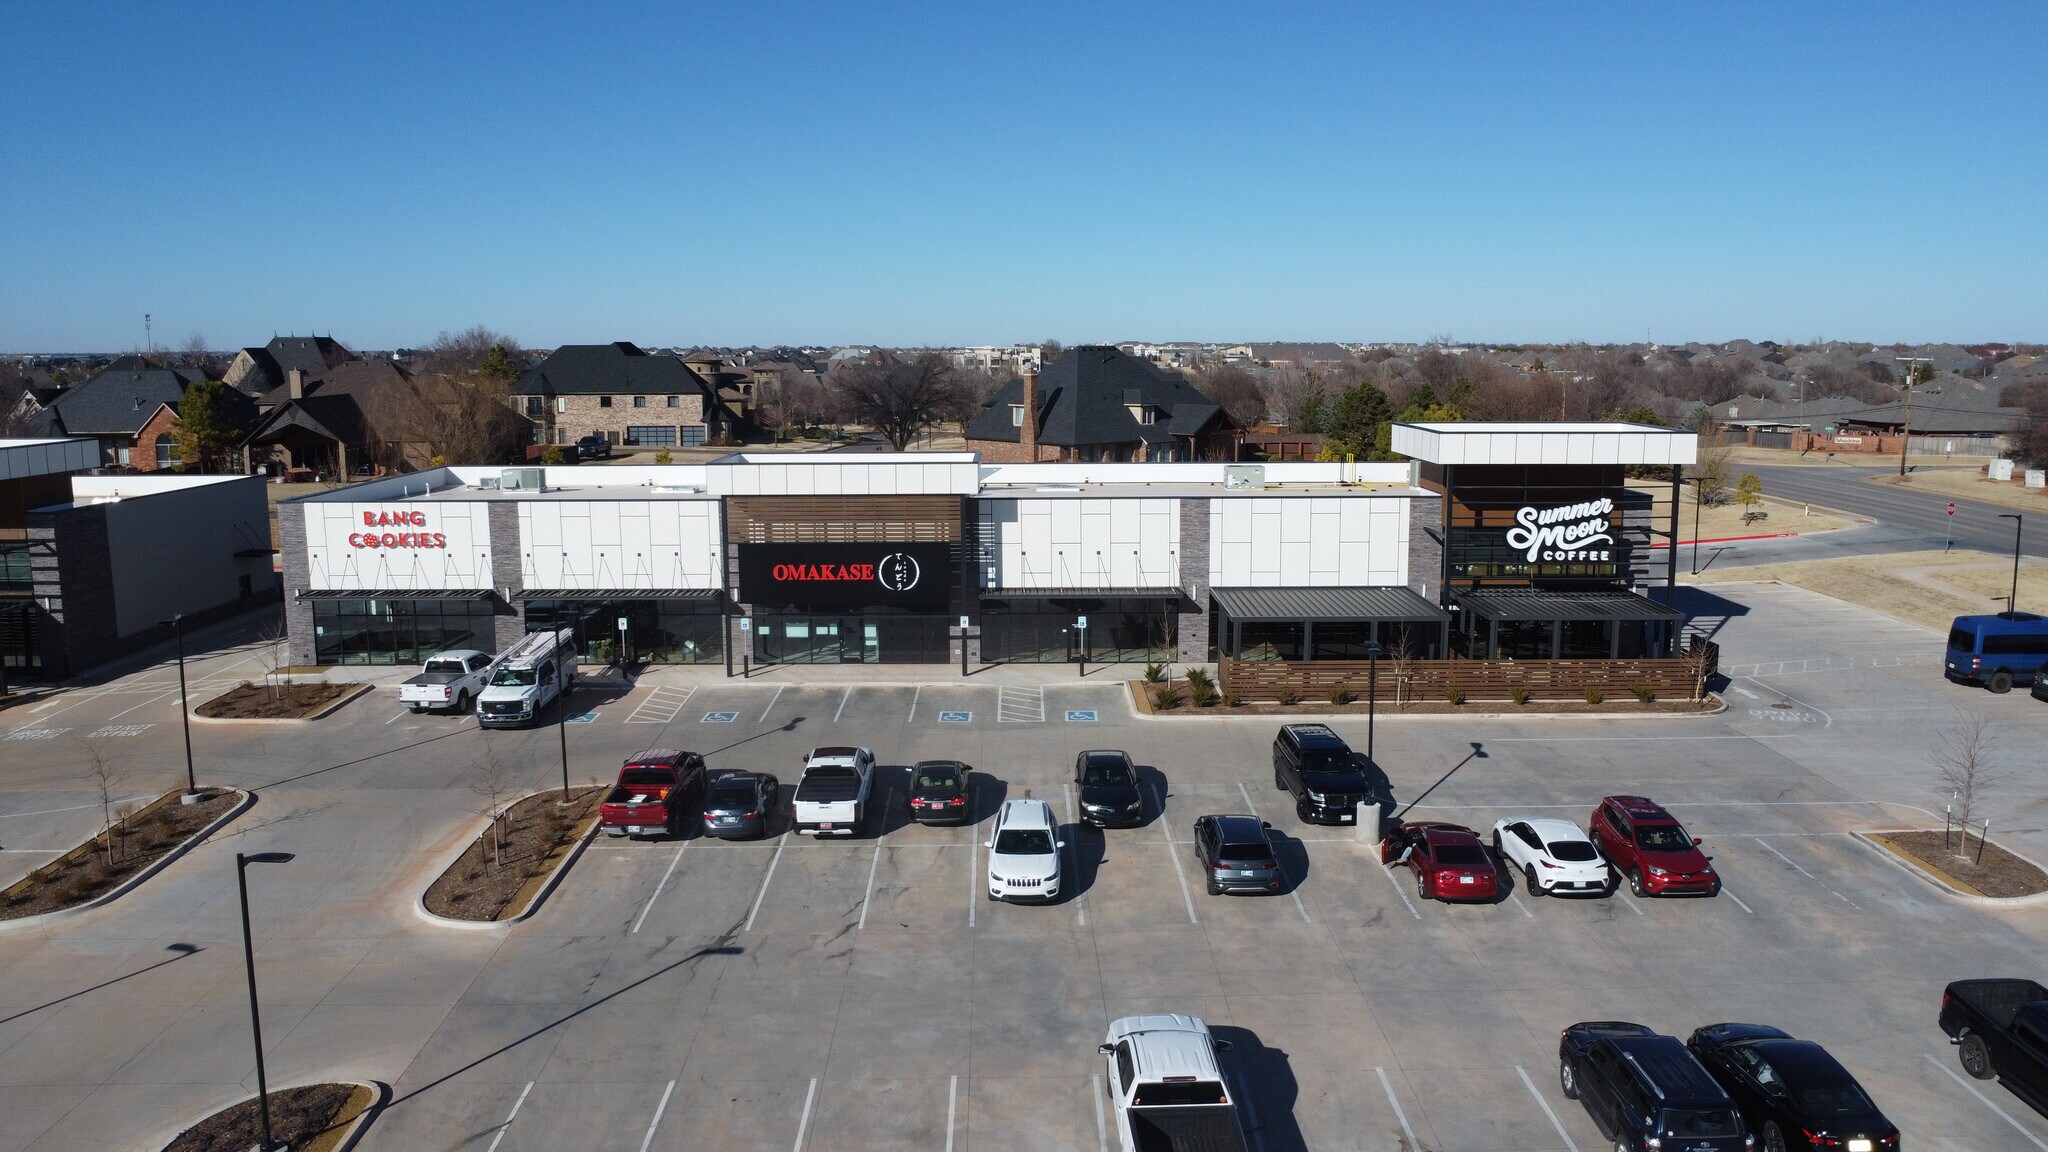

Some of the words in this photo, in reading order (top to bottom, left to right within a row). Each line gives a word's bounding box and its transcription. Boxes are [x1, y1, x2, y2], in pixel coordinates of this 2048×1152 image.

[363, 511, 424, 526] BANG
[1506, 498, 1614, 549] Summer
[348, 533, 446, 548] COOKIES
[1526, 518, 1614, 563] Moon
[1543, 550, 1610, 561] COFFEE
[772, 564, 875, 581] OMAKASE
